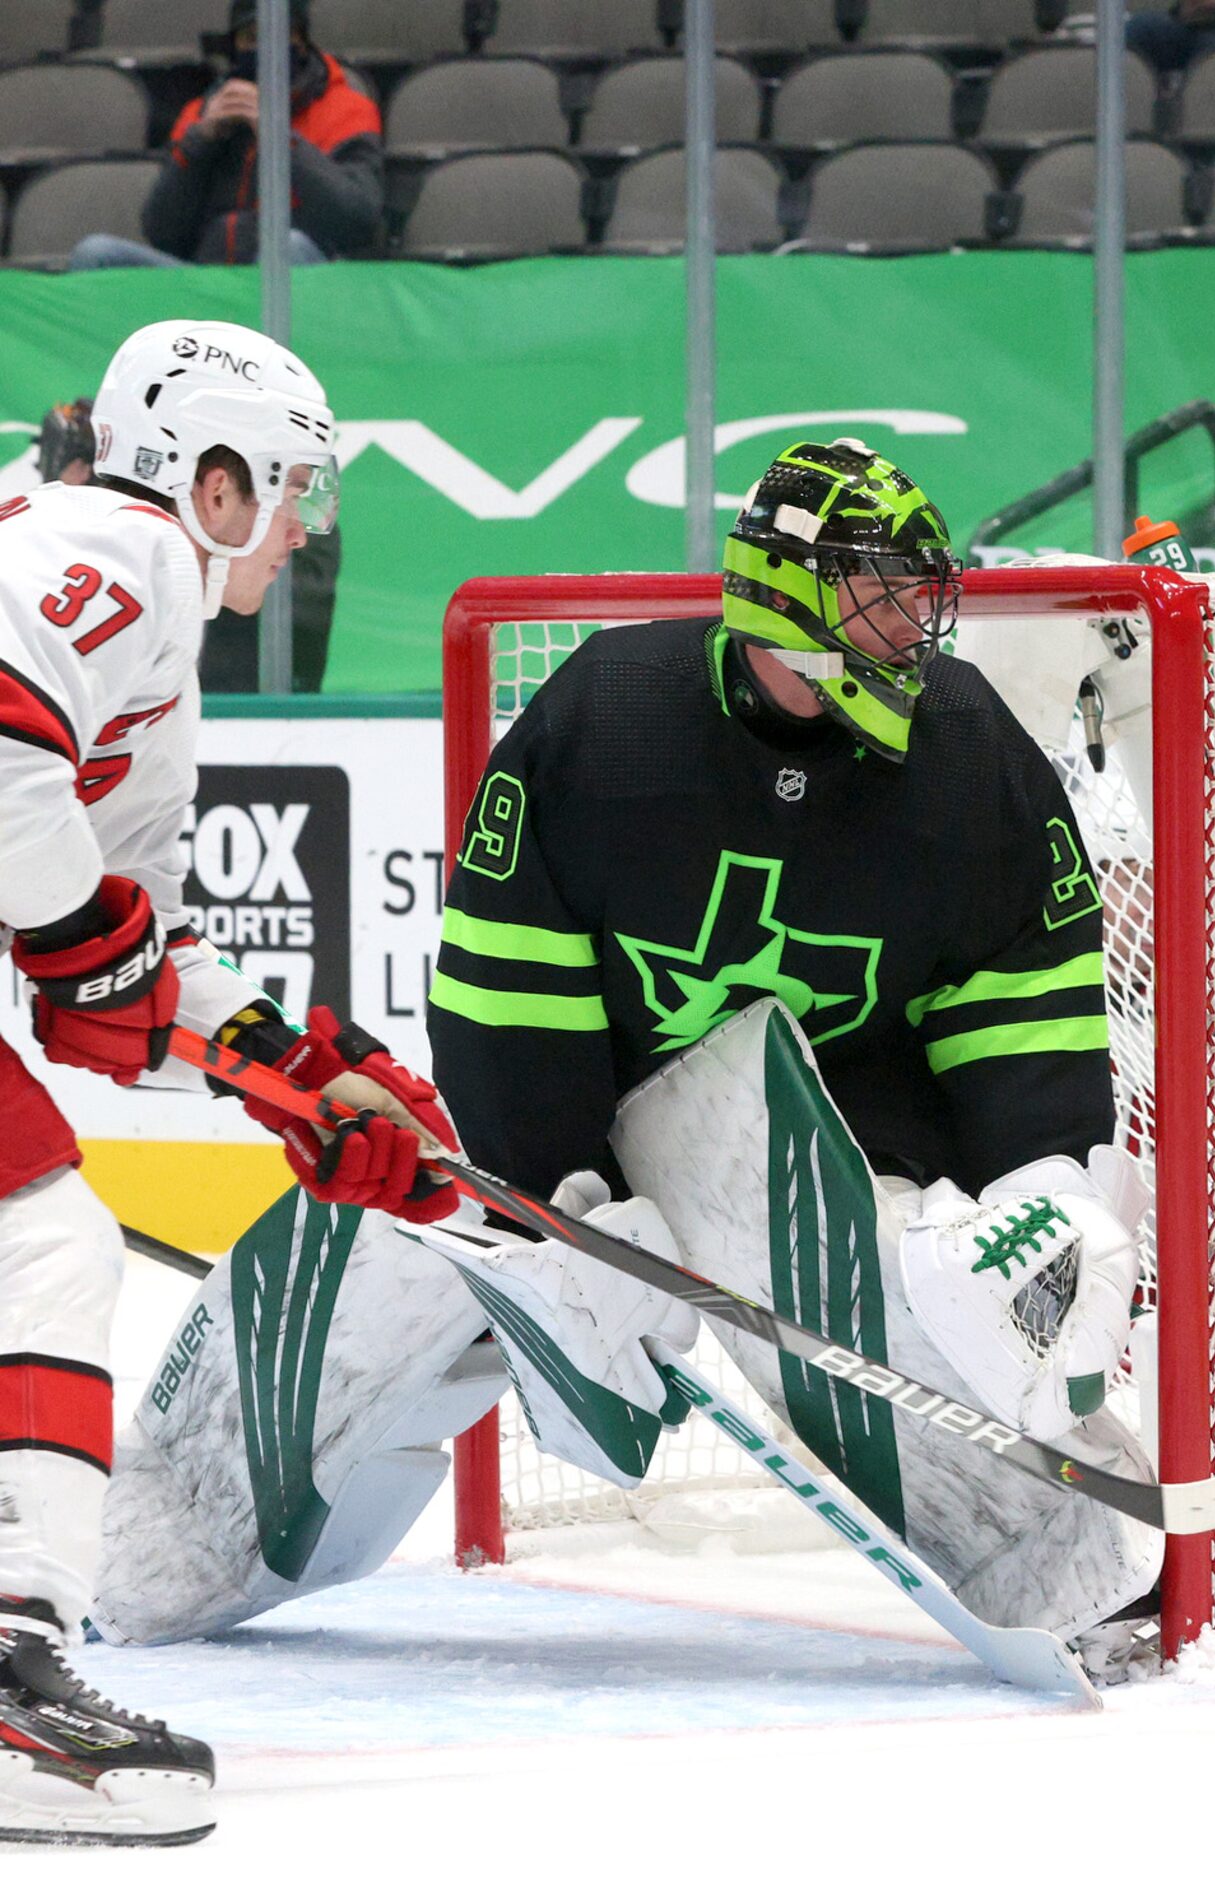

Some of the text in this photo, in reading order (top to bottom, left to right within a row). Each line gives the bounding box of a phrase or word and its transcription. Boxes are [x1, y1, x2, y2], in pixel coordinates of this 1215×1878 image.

[203, 344, 260, 383] PNC
[39, 563, 144, 657] 37
[1149, 541, 1187, 571] 29
[462, 771, 525, 881] 9
[1043, 816, 1104, 932] 2
[151, 1303, 214, 1415] BAUER
[808, 1345, 1022, 1454] BAUER
[664, 1363, 922, 1593] BAUER
